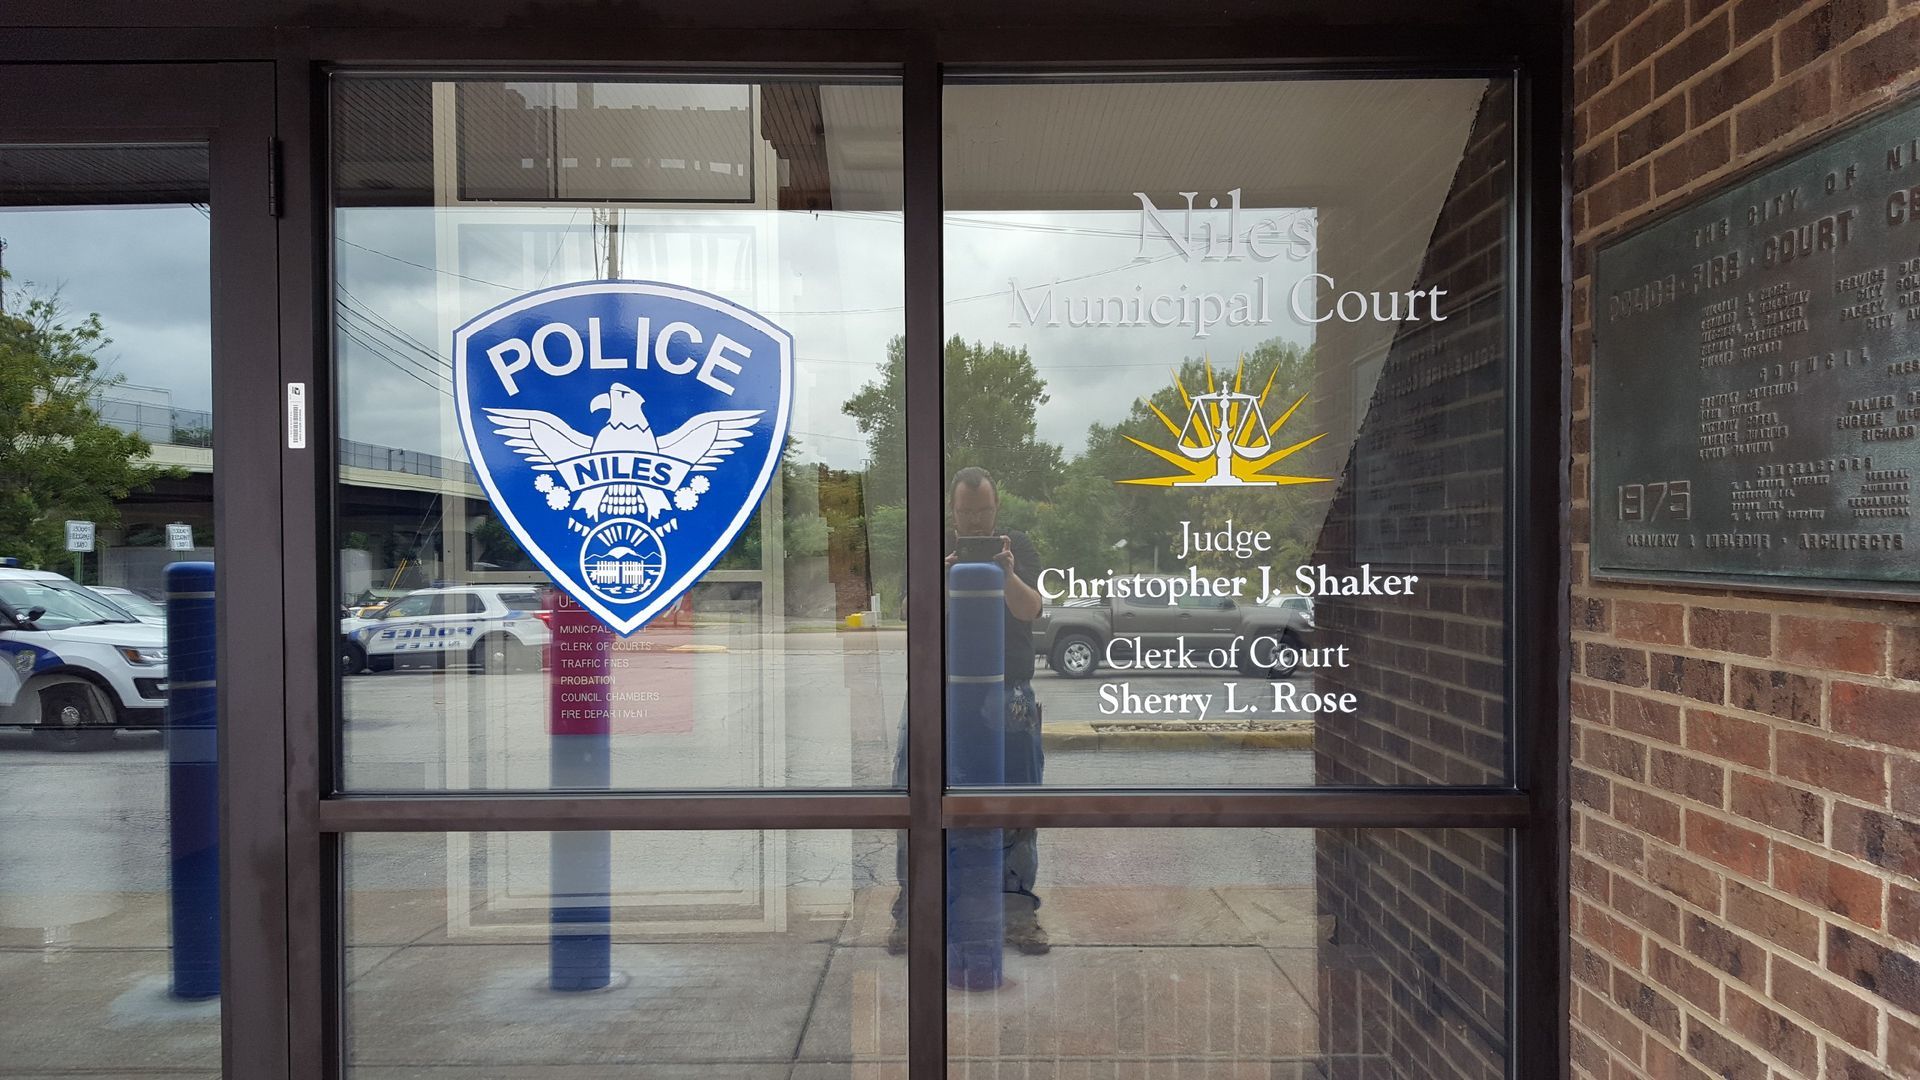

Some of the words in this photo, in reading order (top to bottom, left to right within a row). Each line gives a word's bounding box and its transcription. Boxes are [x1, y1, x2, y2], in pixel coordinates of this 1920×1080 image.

[1694, 217, 1729, 249] THE
[1749, 187, 1801, 226] CITY
[1824, 164, 1858, 194] OF
[1131, 187, 1317, 262] Niles
[1609, 274, 1676, 320] POLICE
[1691, 249, 1741, 294] FIRE
[1764, 207, 1858, 268] COURT
[1007, 273, 1272, 339] Municipal
[1290, 273, 1449, 324] Court
[486, 317, 752, 396] POLICE
[1759, 347, 1871, 382] COUNCIL
[1837, 412, 1884, 429] EUGENE
[573, 457, 673, 487] NILES
[1177, 519, 1272, 560] Judge
[1800, 533, 1905, 550] ARCHITECTS
[1036, 565, 1247, 606] Christopher
[1256, 565, 1282, 603] J.
[1295, 563, 1419, 597] Shaker
[560, 625, 611, 634] MUNICPAL
[560, 642, 593, 651] CLERK
[596, 642, 610, 651] OF
[611, 641, 653, 651] COURTS
[561, 659, 601, 668] TRAFFIC
[604, 659, 630, 668] FNES
[1105, 636, 1197, 670] Clerk
[1208, 636, 1244, 670] of
[1249, 636, 1350, 669] Court
[560, 675, 616, 685] PROBATION
[561, 692, 603, 702] COUNCIL
[605, 692, 660, 701] CHAMBERS
[561, 709, 582, 718] FIRE
[584, 709, 648, 718] DEPARTMENT
[1098, 682, 1213, 721] Sherry
[1223, 682, 1258, 713] L.
[1271, 682, 1358, 713] Rose
